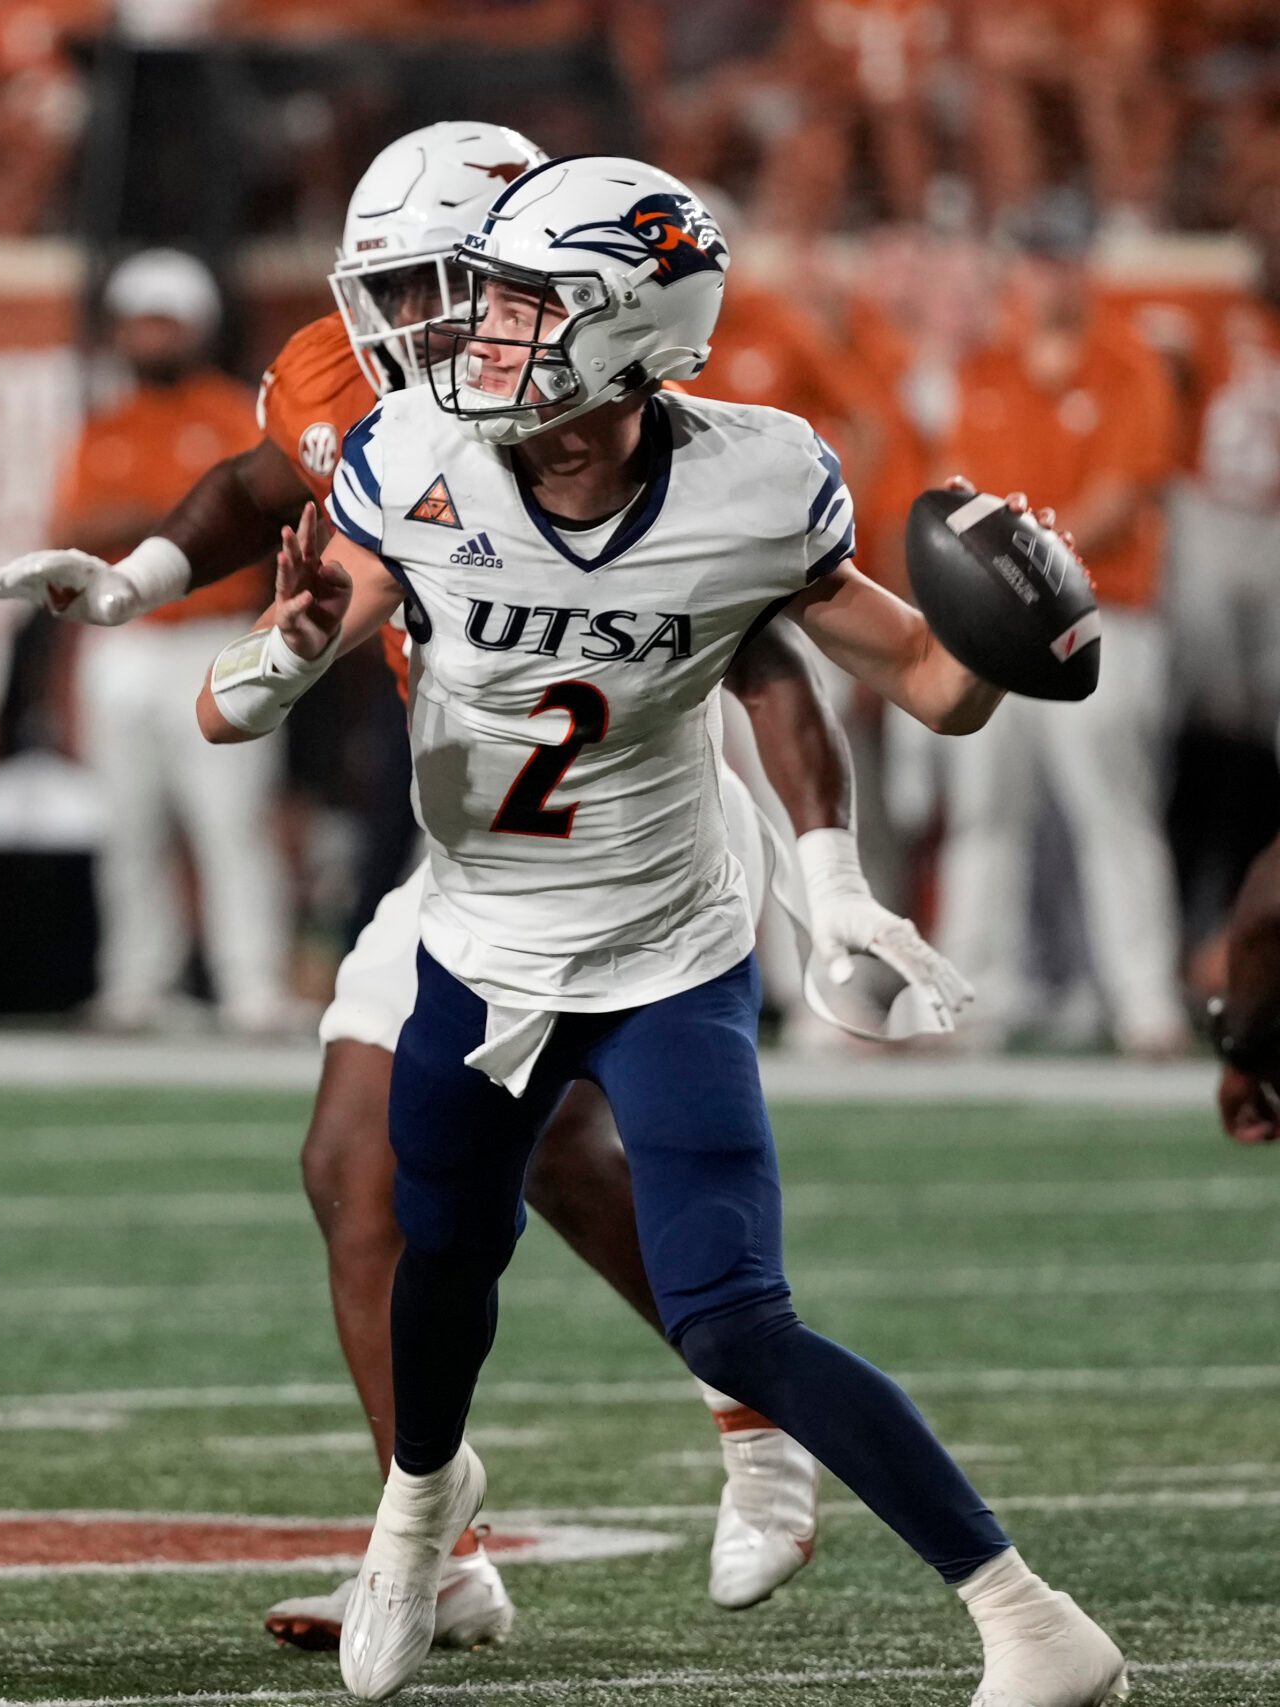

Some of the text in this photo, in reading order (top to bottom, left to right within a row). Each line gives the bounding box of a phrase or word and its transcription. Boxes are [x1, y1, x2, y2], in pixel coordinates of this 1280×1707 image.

[449, 552, 504, 569] adidas
[464, 597, 694, 663] UTSA
[490, 680, 609, 839] 2
